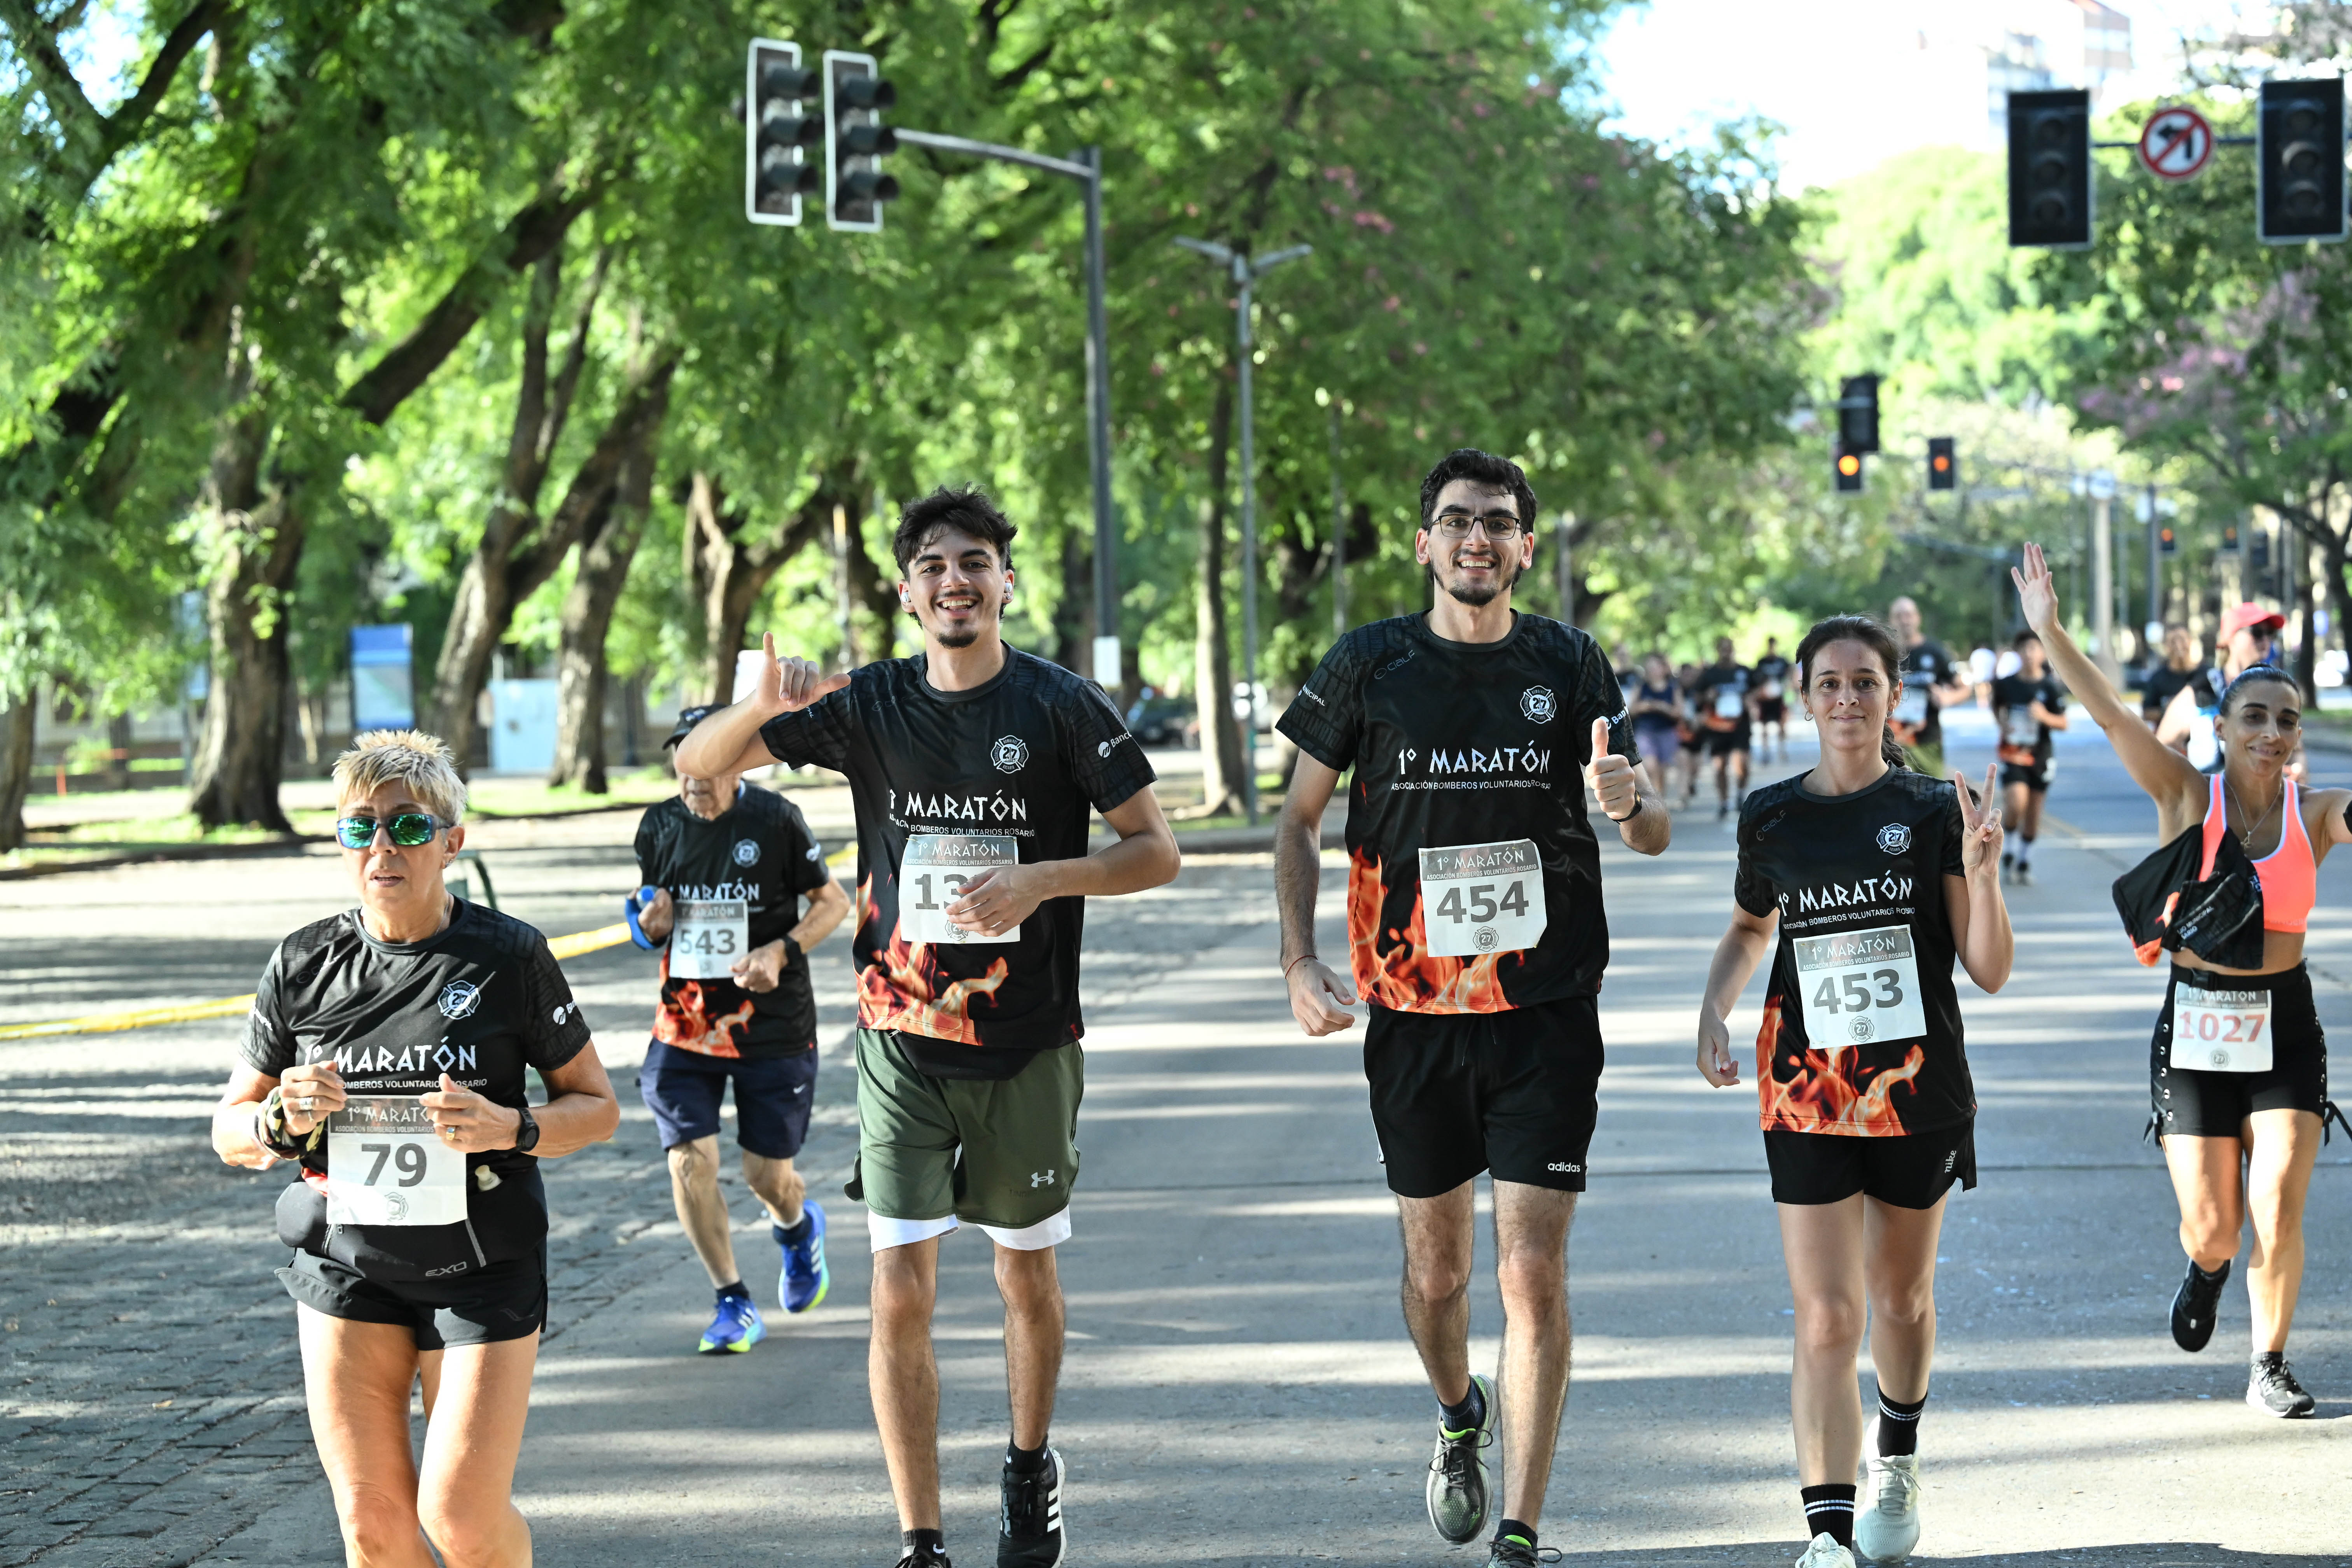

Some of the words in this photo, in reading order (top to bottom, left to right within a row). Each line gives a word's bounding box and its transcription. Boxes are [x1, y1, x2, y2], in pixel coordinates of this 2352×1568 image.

[1302, 683, 1325, 706] UNICIPAL
[1533, 697, 1547, 709] 27
[1003, 747, 1017, 759] 27
[1429, 740, 1550, 774] MARATÓN
[1391, 780, 1433, 791] ASOCIACIÓN
[1433, 781, 1477, 790] BOMBEROS
[1479, 780, 1531, 789] VOLUNTARIOS
[905, 789, 1026, 821] MARATÓN
[911, 824, 949, 835] BOMBEROS
[951, 828, 1002, 836] VOLUNTARIOS
[1004, 828, 1035, 837] ROSARIO
[1888, 832, 1902, 842] 27
[932, 840, 1000, 857] MARATÓN
[1454, 847, 1524, 870] MARATÓN
[1427, 872, 1455, 880] ASOCIACIÓN
[1484, 867, 1516, 875] VOLUNTARIOS
[1517, 864, 1537, 872] ROSARIO
[915, 874, 978, 910] 13
[1799, 870, 1912, 912] MARATÓN
[1437, 880, 1529, 924] 454
[1809, 914, 1847, 926] BOMBEROS
[1848, 907, 1894, 920] VOLUNTARIOS
[680, 928, 736, 954] 543
[1481, 934, 1491, 943] 27
[1827, 934, 1895, 958] MARATÓN
[1803, 962, 1829, 971] ASOCIACIÓN
[1829, 958, 1854, 968] BOMBEROS
[1855, 955, 1887, 964] VOLUNTARIOS
[452, 993, 468, 1005] 27
[1814, 969, 1903, 1014] 453
[1856, 1024, 1866, 1033] 27
[2179, 1011, 2264, 1042] 1027
[333, 1036, 476, 1072] MARATÓN
[342, 1080, 383, 1089] OMBEROS
[385, 1080, 439, 1088] VOLUNTARIO
[454, 1079, 487, 1087] OSARIO
[362, 1143, 427, 1187] 79
[1547, 1162, 1580, 1172] adidas
[1944, 1150, 1956, 1173] nike
[425, 1261, 467, 1276] EXO
